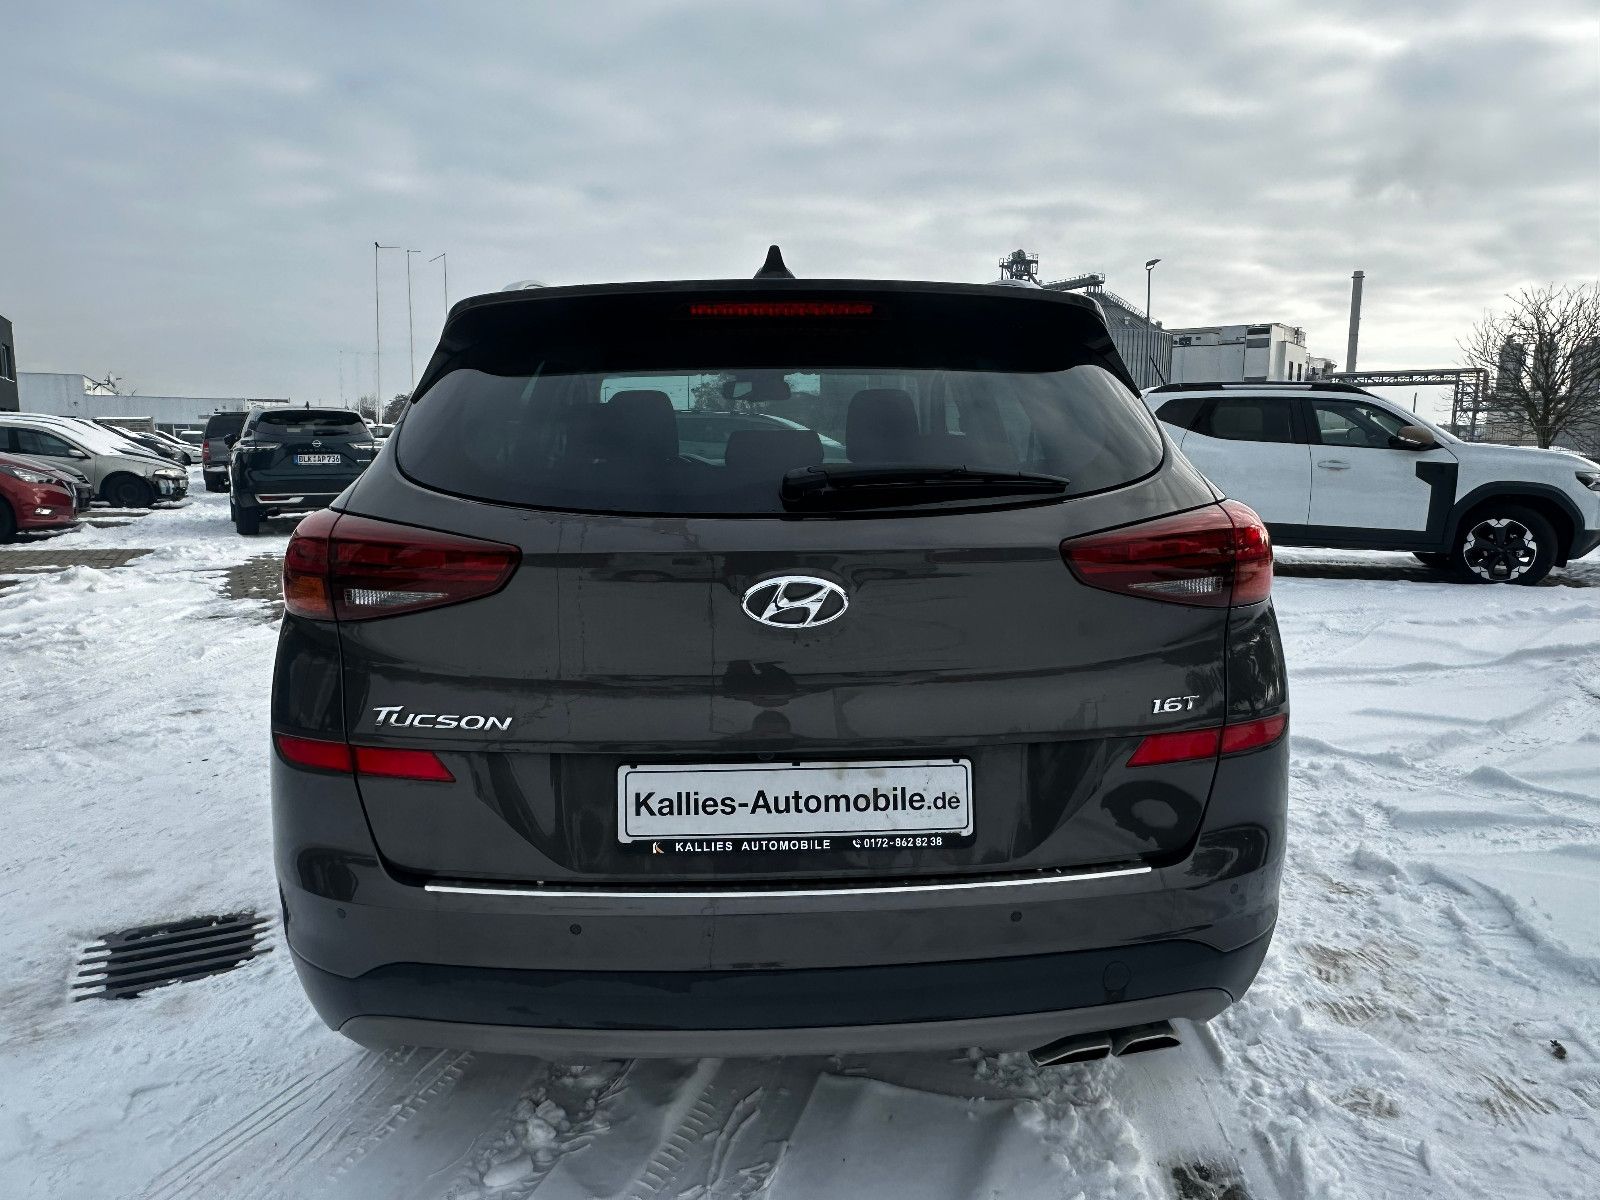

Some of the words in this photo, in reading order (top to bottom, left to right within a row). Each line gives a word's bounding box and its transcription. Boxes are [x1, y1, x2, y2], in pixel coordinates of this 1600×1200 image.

[373, 706, 512, 730] TUCSON
[634, 787, 961, 817] Kallies-Automobile.de
[675, 841, 733, 852] KALLIES
[741, 839, 831, 851] AUTOMOBILE
